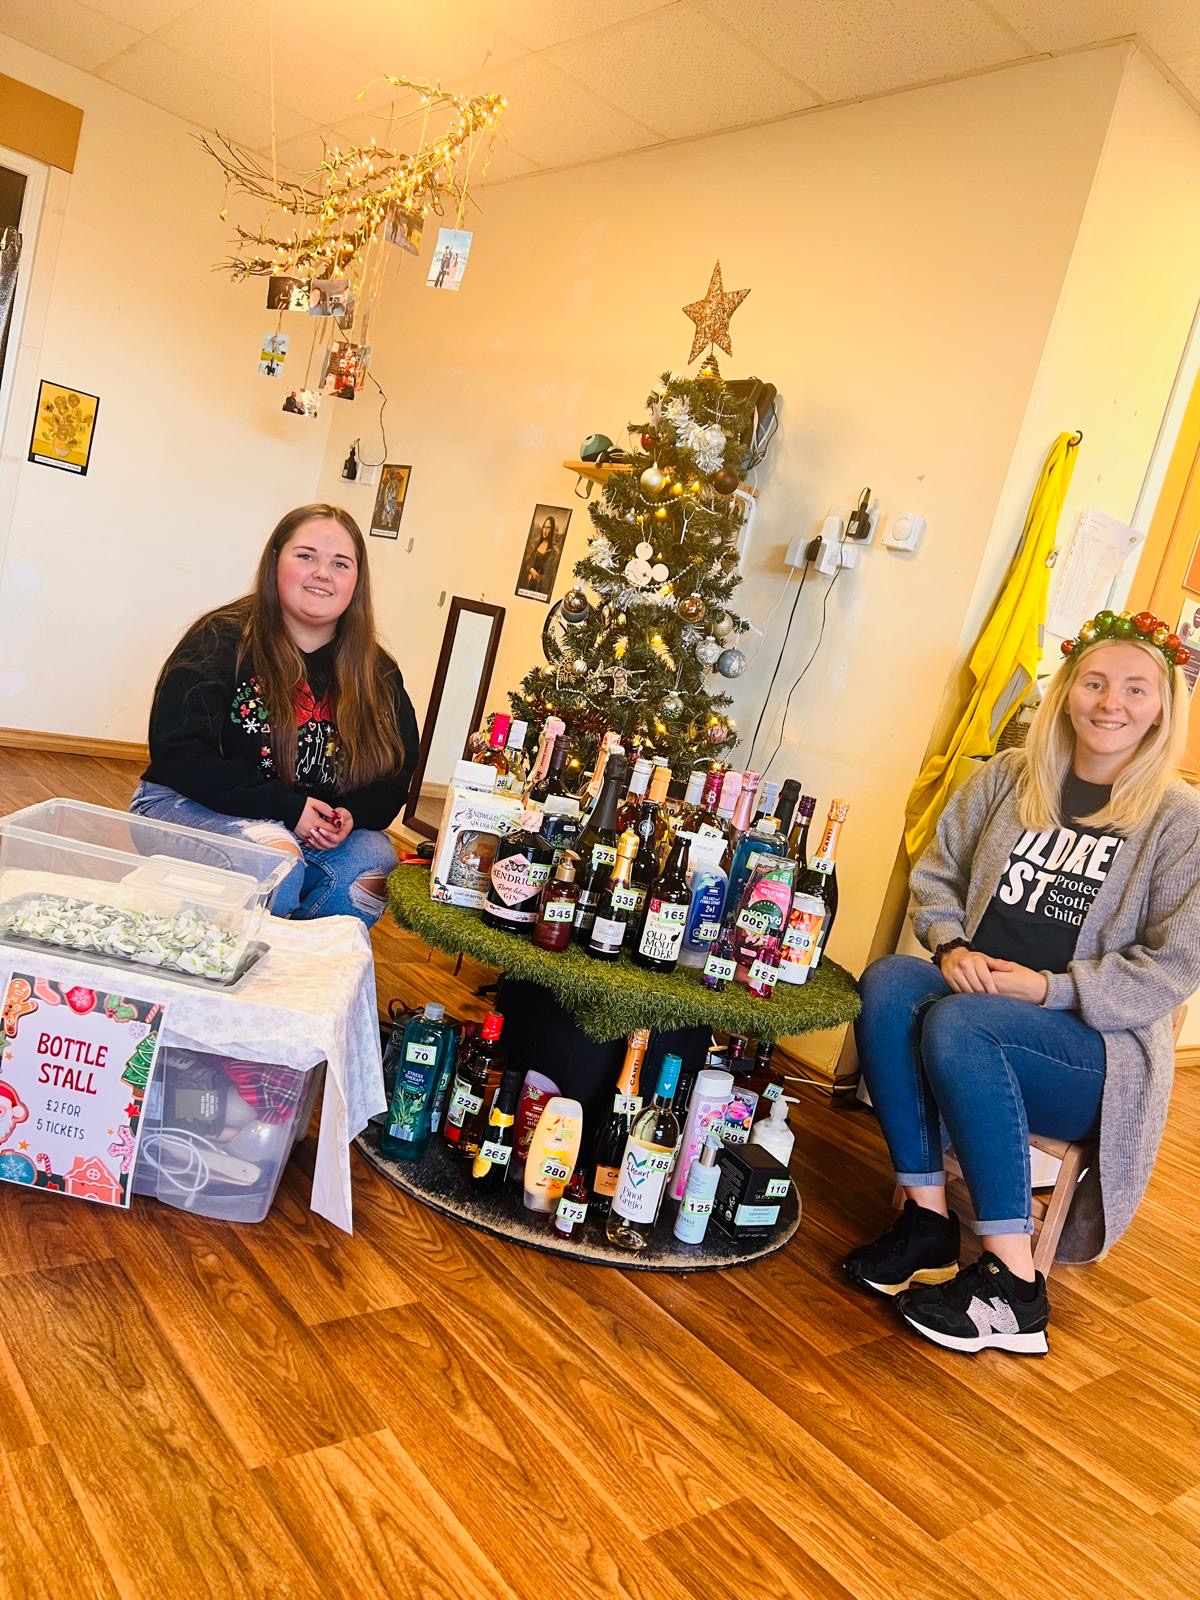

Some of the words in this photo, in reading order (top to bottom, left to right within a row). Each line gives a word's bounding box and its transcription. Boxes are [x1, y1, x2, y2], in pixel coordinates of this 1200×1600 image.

[822, 828, 833, 853] CANTI
[596, 851, 615, 863] 275
[1012, 827, 1125, 881] ILDRE
[531, 870, 548, 880] 270
[999, 858, 1059, 914] ST
[1055, 875, 1100, 898] Protec
[503, 892, 518, 901] GIN
[615, 895, 634, 907] 335
[1047, 889, 1093, 911] Scotla
[548, 909, 571, 919] 345
[663, 910, 685, 920] 165
[741, 912, 764, 929] 300
[1044, 904, 1084, 927] Child
[646, 930, 667, 941] OLD
[702, 928, 718, 938] 310
[645, 938, 675, 951] MOUT
[787, 935, 810, 947] 290
[642, 945, 673, 960] CIDER
[709, 962, 732, 977] 230
[754, 968, 776, 982] 195
[37, 1032, 109, 1068] BOTTLE
[414, 1051, 428, 1061] 70
[38, 1062, 97, 1095] STALL
[629, 1059, 639, 1086] CANTI
[766, 1089, 779, 1098] 170
[46, 1099, 59, 1113] £2
[61, 1102, 81, 1117] FOR
[457, 1097, 478, 1111] 225
[622, 1102, 636, 1111] 15
[36, 1118, 43, 1130] 5
[46, 1120, 85, 1140] TICKETS
[724, 1132, 745, 1144] 205
[484, 1148, 507, 1160] 265
[650, 1158, 669, 1170] 185
[544, 1165, 566, 1179] 280
[770, 1185, 787, 1194] 110
[562, 1206, 583, 1220] 175
[689, 1203, 711, 1213] 125
